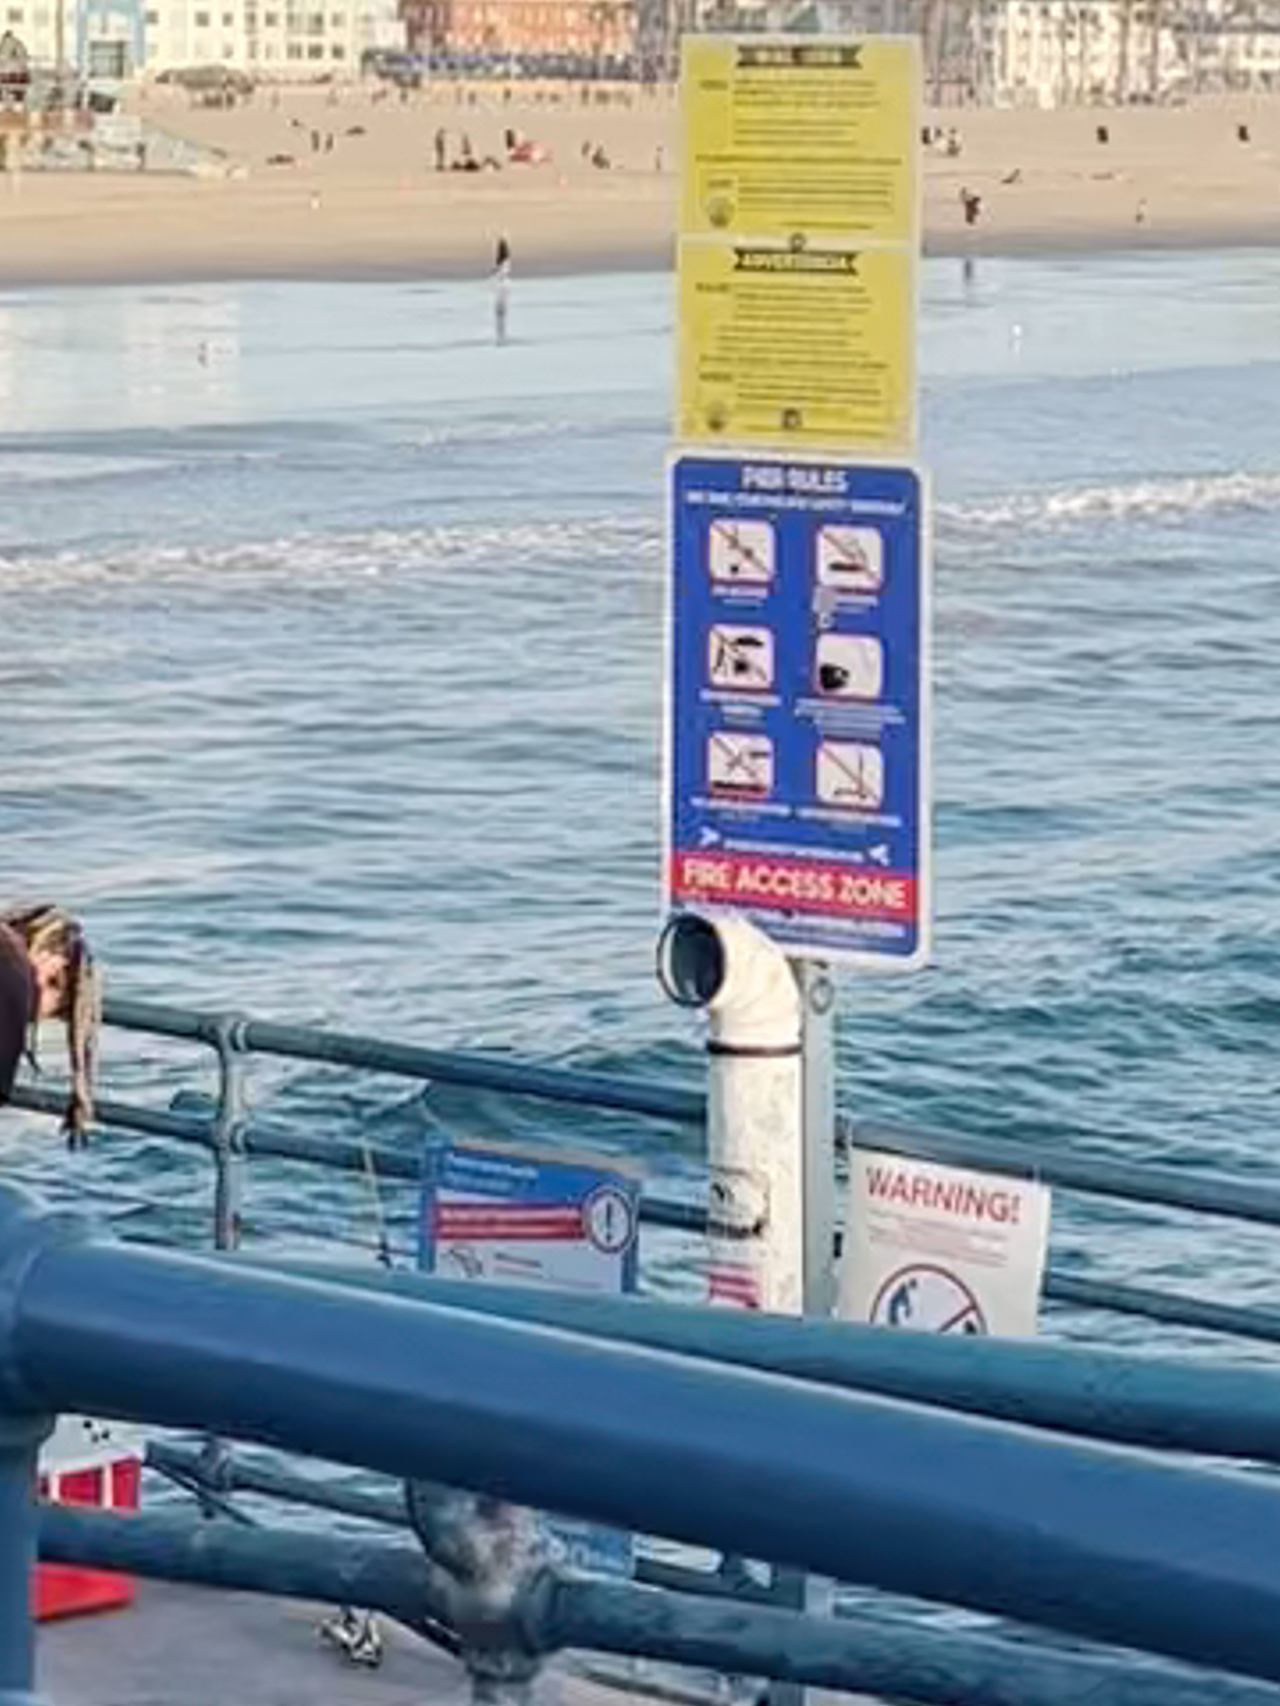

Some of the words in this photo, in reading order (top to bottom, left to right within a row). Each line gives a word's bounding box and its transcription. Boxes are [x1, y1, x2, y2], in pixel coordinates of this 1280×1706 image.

[683, 858, 732, 889] FIRE
[737, 865, 835, 901] ACCESS
[839, 873, 907, 909] ZONE
[866, 1166, 1021, 1224] WARNING!
